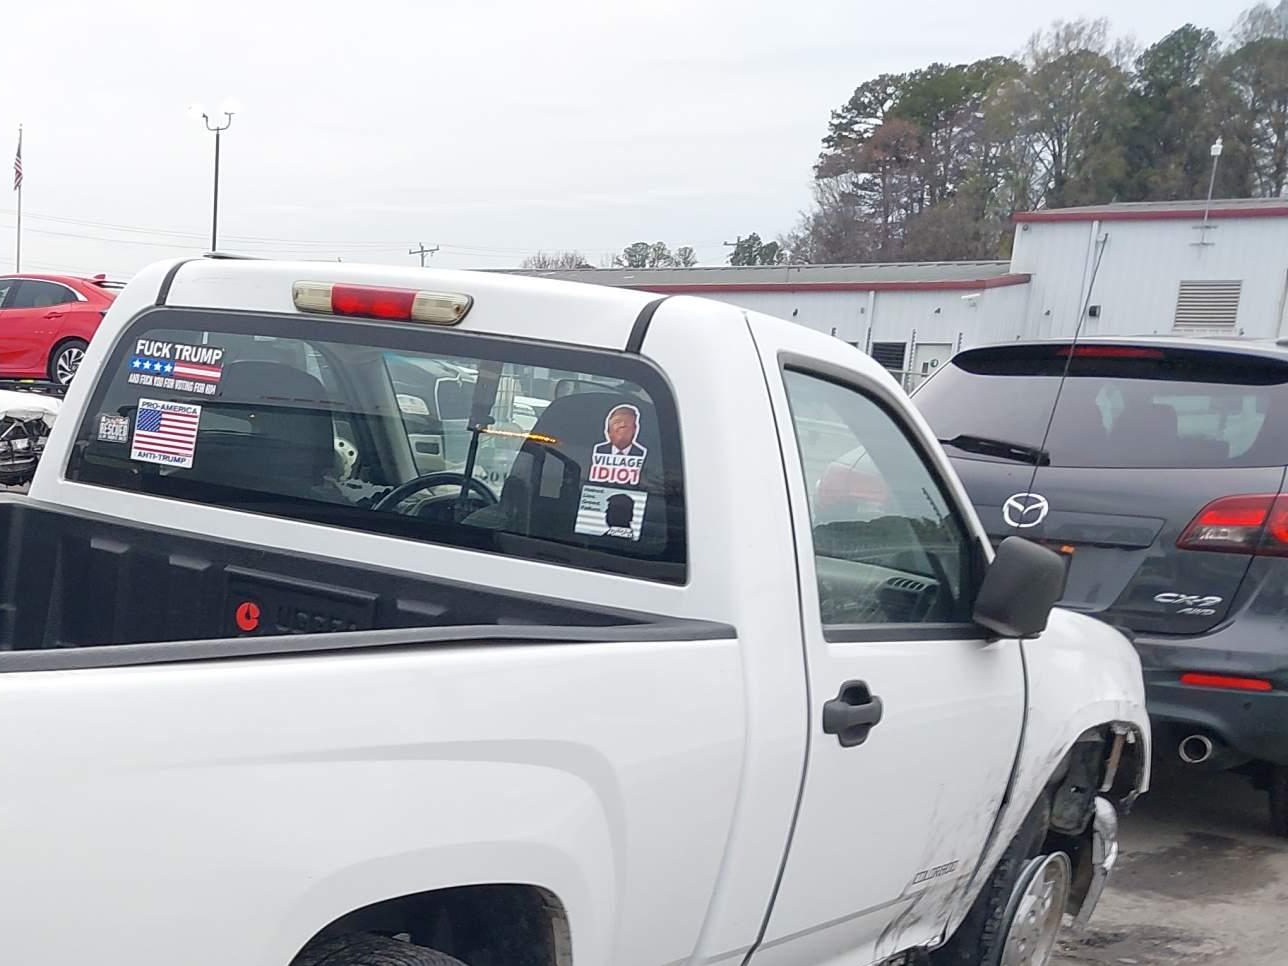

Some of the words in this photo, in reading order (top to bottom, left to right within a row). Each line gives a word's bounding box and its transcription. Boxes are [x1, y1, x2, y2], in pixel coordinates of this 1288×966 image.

[136, 340, 171, 358] FUCK
[174, 345, 222, 364] TRUMP
[140, 375, 152, 385] FUCK
[154, 377, 163, 386] YOU
[164, 378, 174, 388] FOR
[194, 383, 205, 393] FOR
[141, 401, 198, 415] PRO-AMERICA
[137, 452, 186, 463] ANTI-TRUMP
[594, 455, 643, 468] VILLAGE
[592, 467, 639, 482] IDIOT
